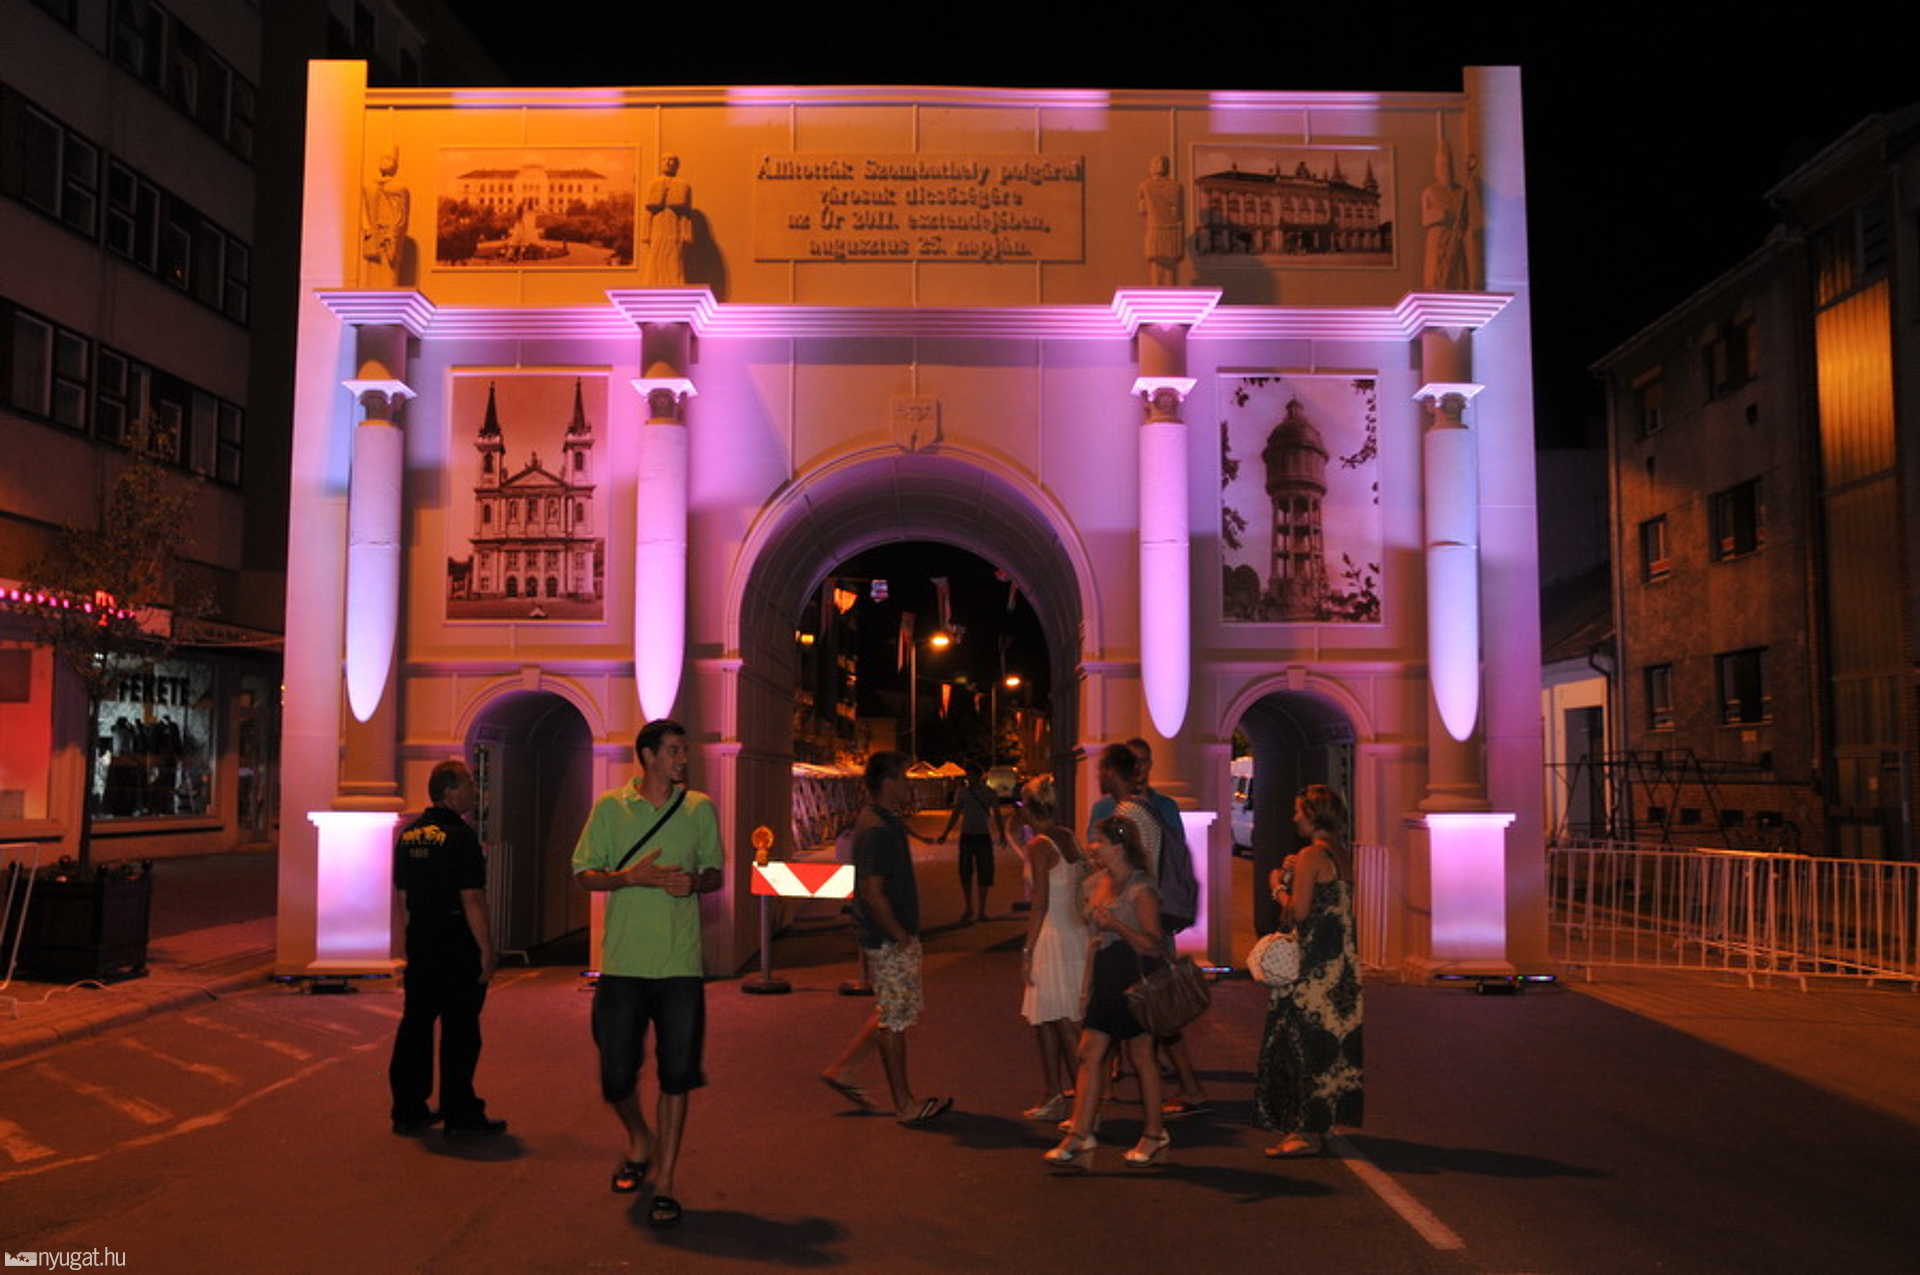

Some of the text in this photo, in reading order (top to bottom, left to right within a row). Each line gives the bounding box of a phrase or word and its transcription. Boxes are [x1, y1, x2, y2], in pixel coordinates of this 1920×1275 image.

[864, 159, 990, 186] Szombathely
[1000, 160, 1085, 186] polgárai
[820, 186, 1024, 209] városuk dicsőségére
[787, 212, 812, 230] az
[820, 206, 847, 231] Úr
[809, 238, 911, 260] augusztus
